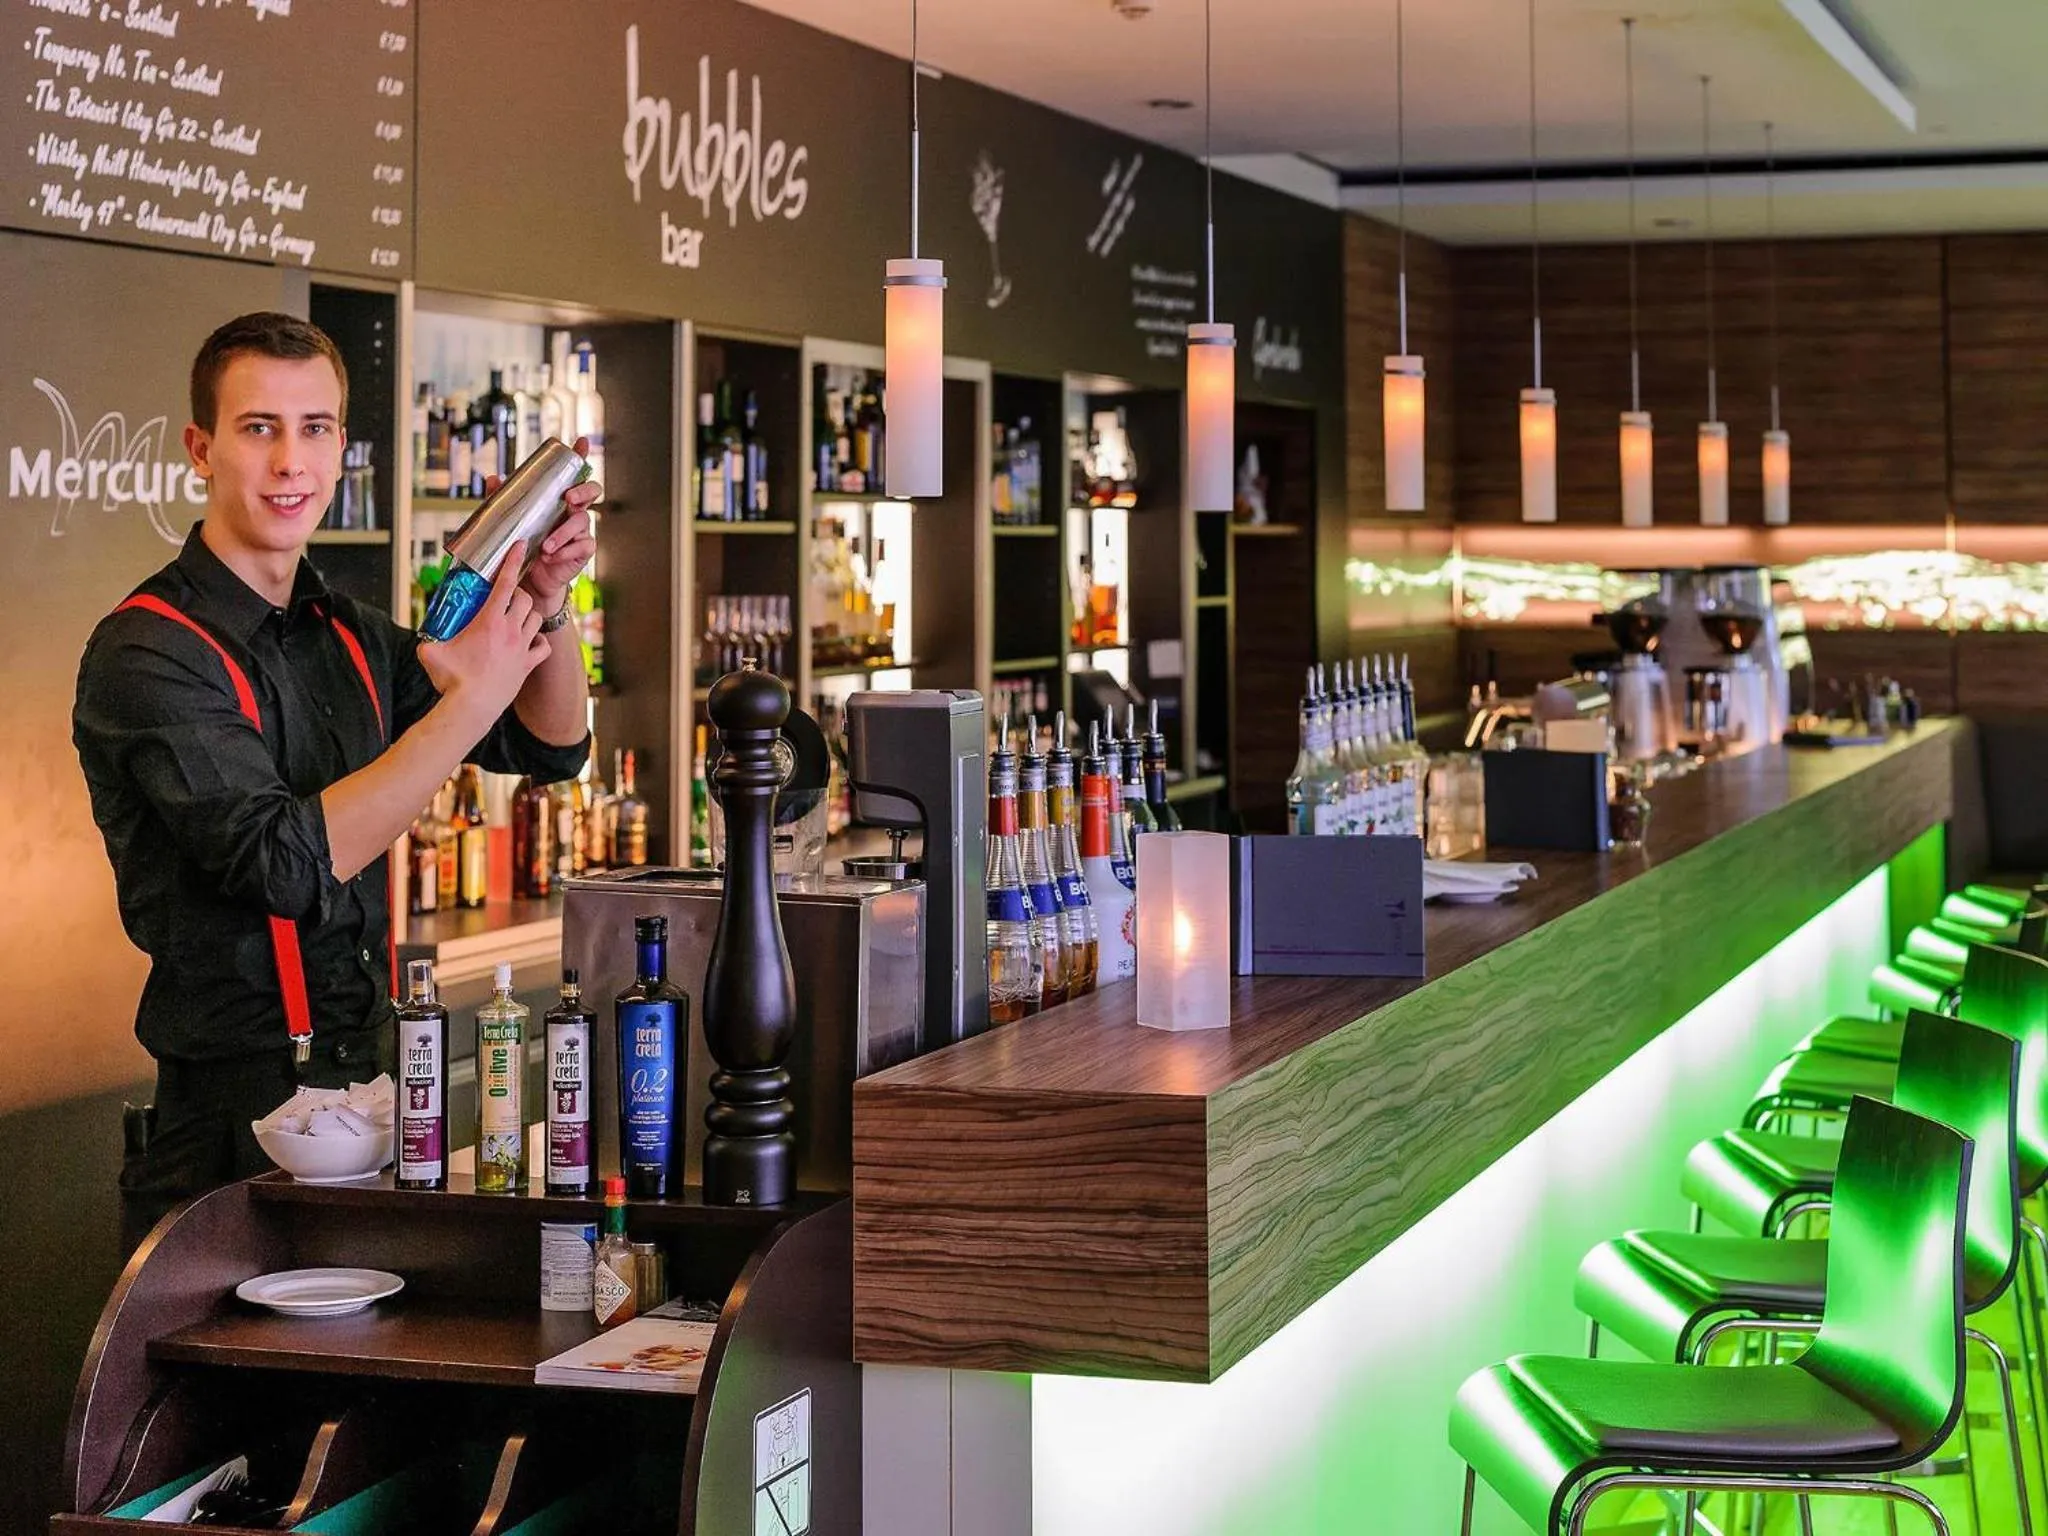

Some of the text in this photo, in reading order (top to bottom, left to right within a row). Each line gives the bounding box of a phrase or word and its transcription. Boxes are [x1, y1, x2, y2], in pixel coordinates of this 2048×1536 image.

[35, 79, 62, 112] The
[178, 117, 199, 142] 22
[623, 24, 808, 227] bubbles
[661, 211, 703, 268] bar
[9, 446, 209, 505] Mercure
[635, 1027, 662, 1043] terra
[408, 1047, 432, 1062] terra
[556, 1051, 580, 1065] terra
[635, 1043, 662, 1058] creta
[408, 1062, 432, 1076] creta
[555, 1066, 580, 1080] creta
[631, 1068, 669, 1093] 0.2
